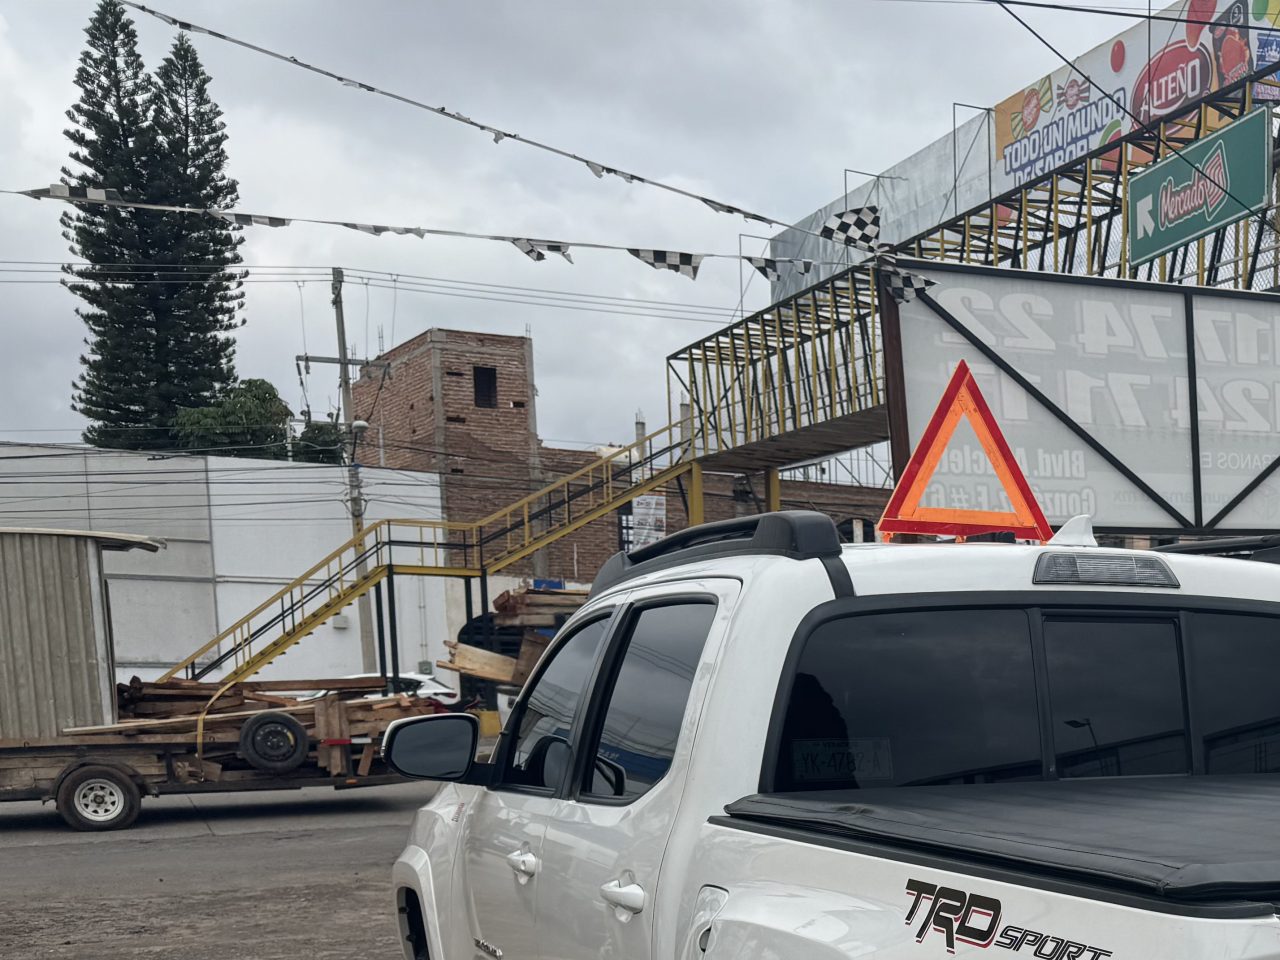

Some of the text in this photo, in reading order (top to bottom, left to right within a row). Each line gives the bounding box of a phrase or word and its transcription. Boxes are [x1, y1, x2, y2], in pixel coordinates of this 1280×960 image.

[1139, 57, 1201, 120] ALTEÑO
[1003, 129, 1041, 176] TODO
[1042, 117, 1065, 155] UN
[1066, 86, 1127, 143] MUNDO
[1160, 166, 1207, 228] Mercado
[904, 878, 1003, 955] TRD
